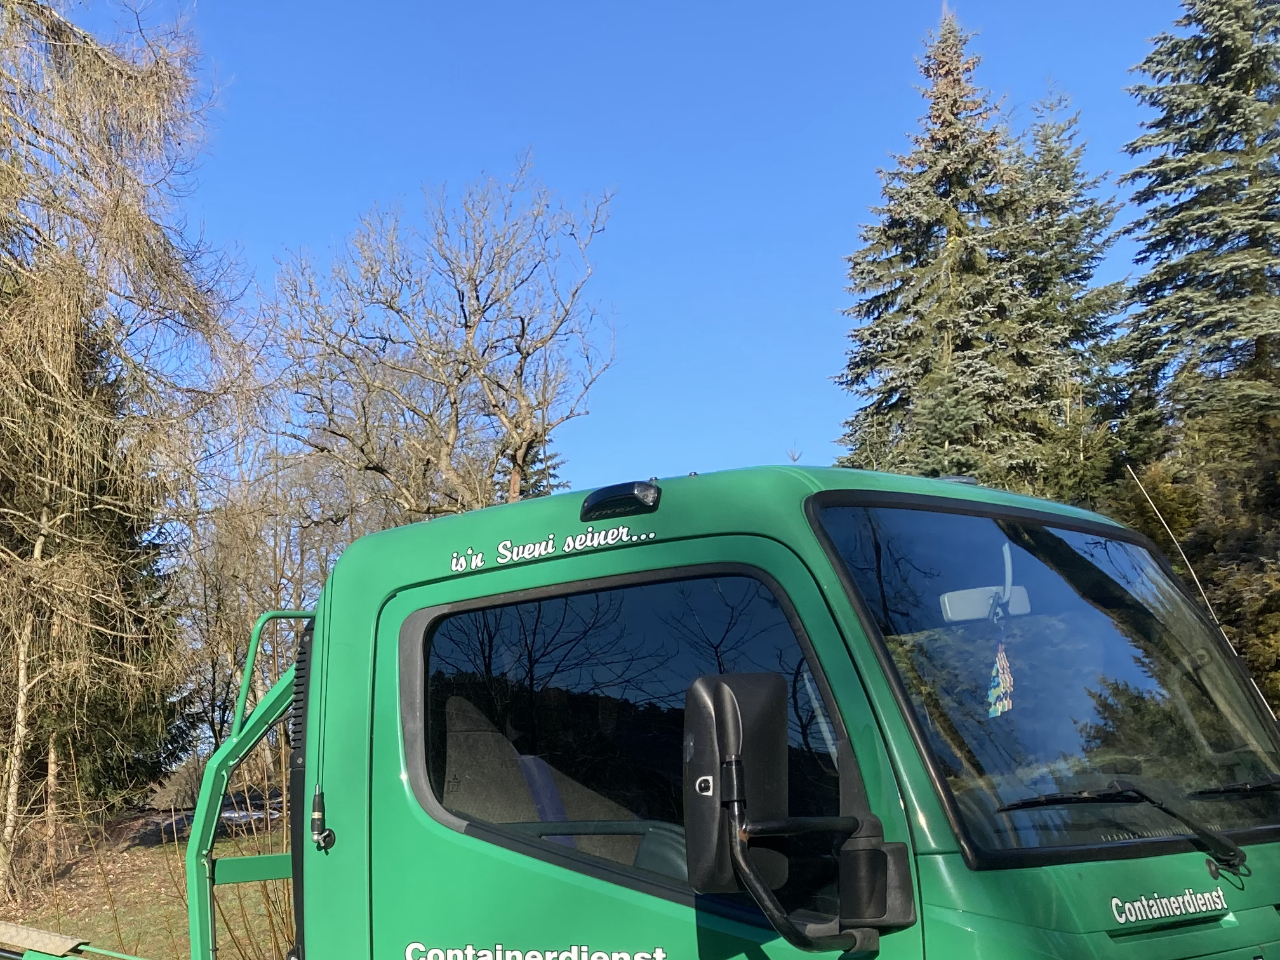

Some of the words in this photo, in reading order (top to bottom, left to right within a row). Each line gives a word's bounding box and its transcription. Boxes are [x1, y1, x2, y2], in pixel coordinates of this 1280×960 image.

[496, 534, 555, 564] Sveni
[562, 525, 656, 553] seiner...
[1111, 886, 1228, 924] Containerdienst
